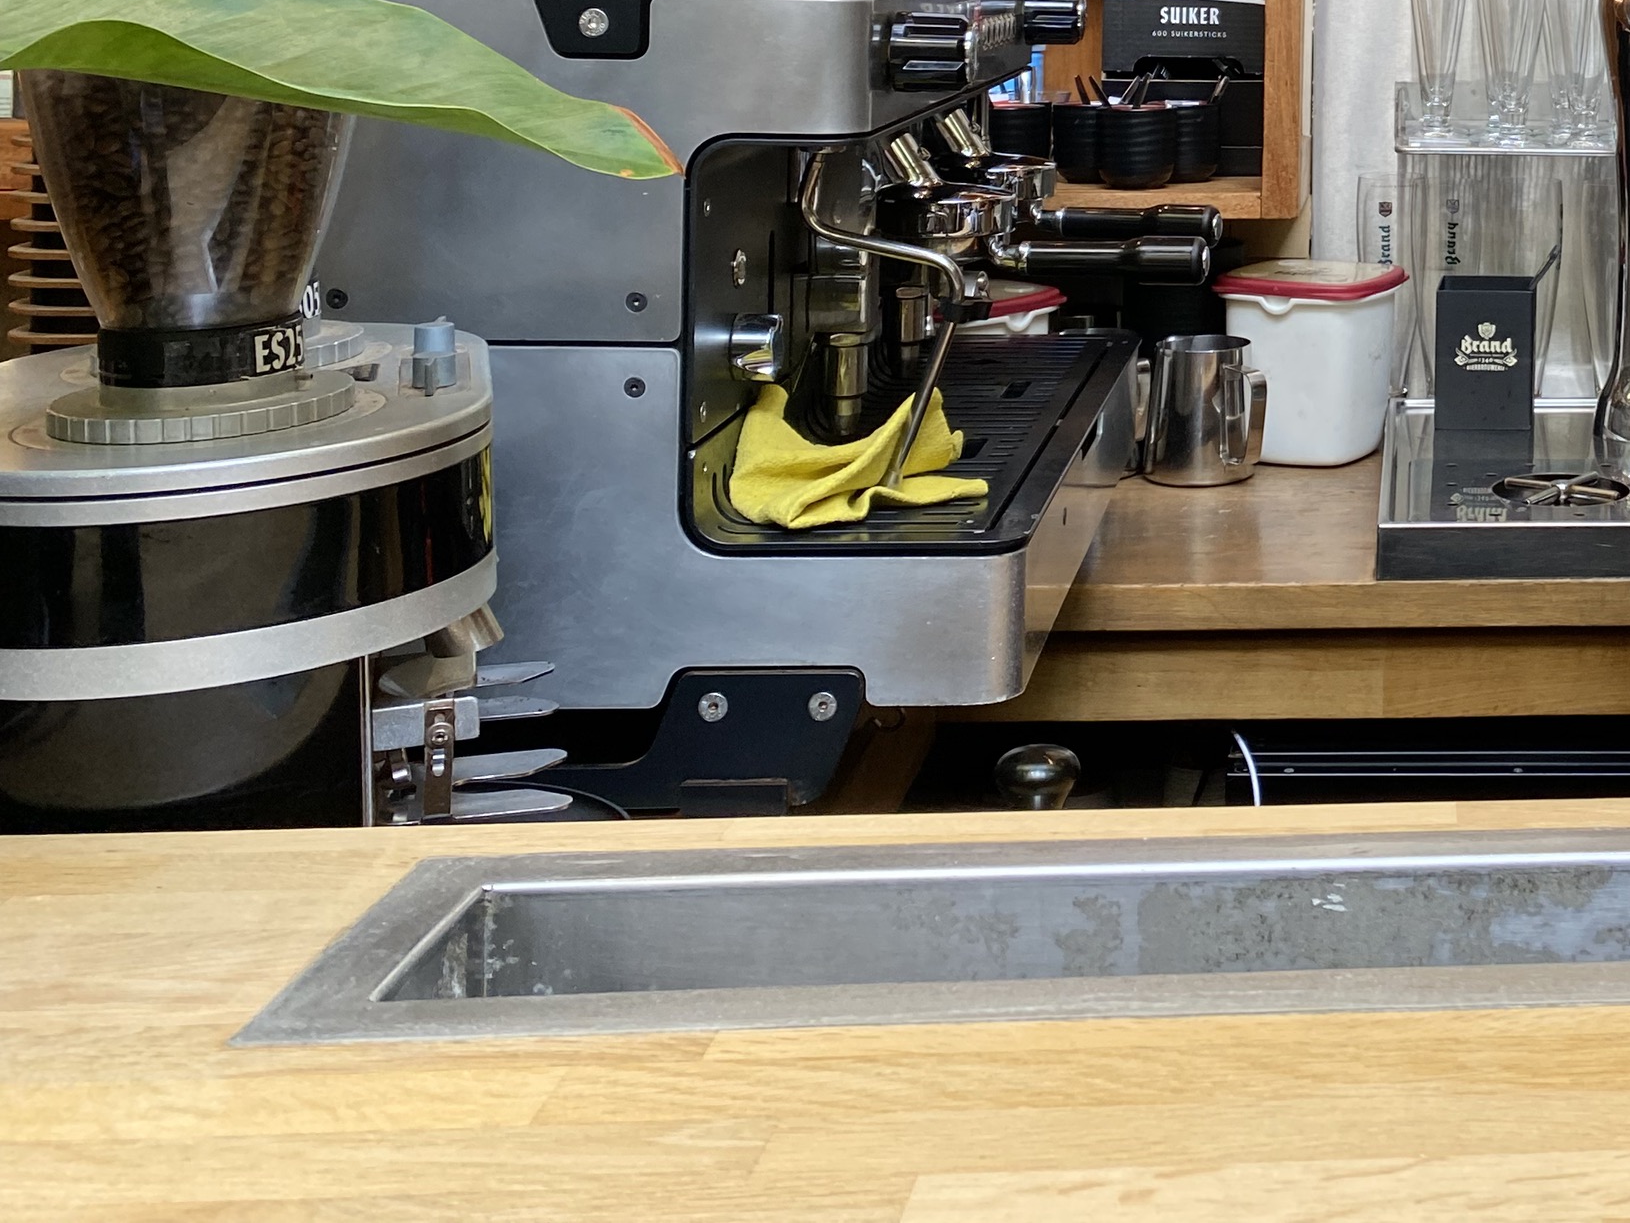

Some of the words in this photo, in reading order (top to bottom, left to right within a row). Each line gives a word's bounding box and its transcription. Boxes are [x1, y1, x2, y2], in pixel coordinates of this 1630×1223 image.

[1160, 6, 1220, 26] SUIKER
[1152, 30, 1168, 38] 600
[1171, 30, 1227, 39] SUIKERSTICKS
[1461, 334, 1513, 355] Brand
